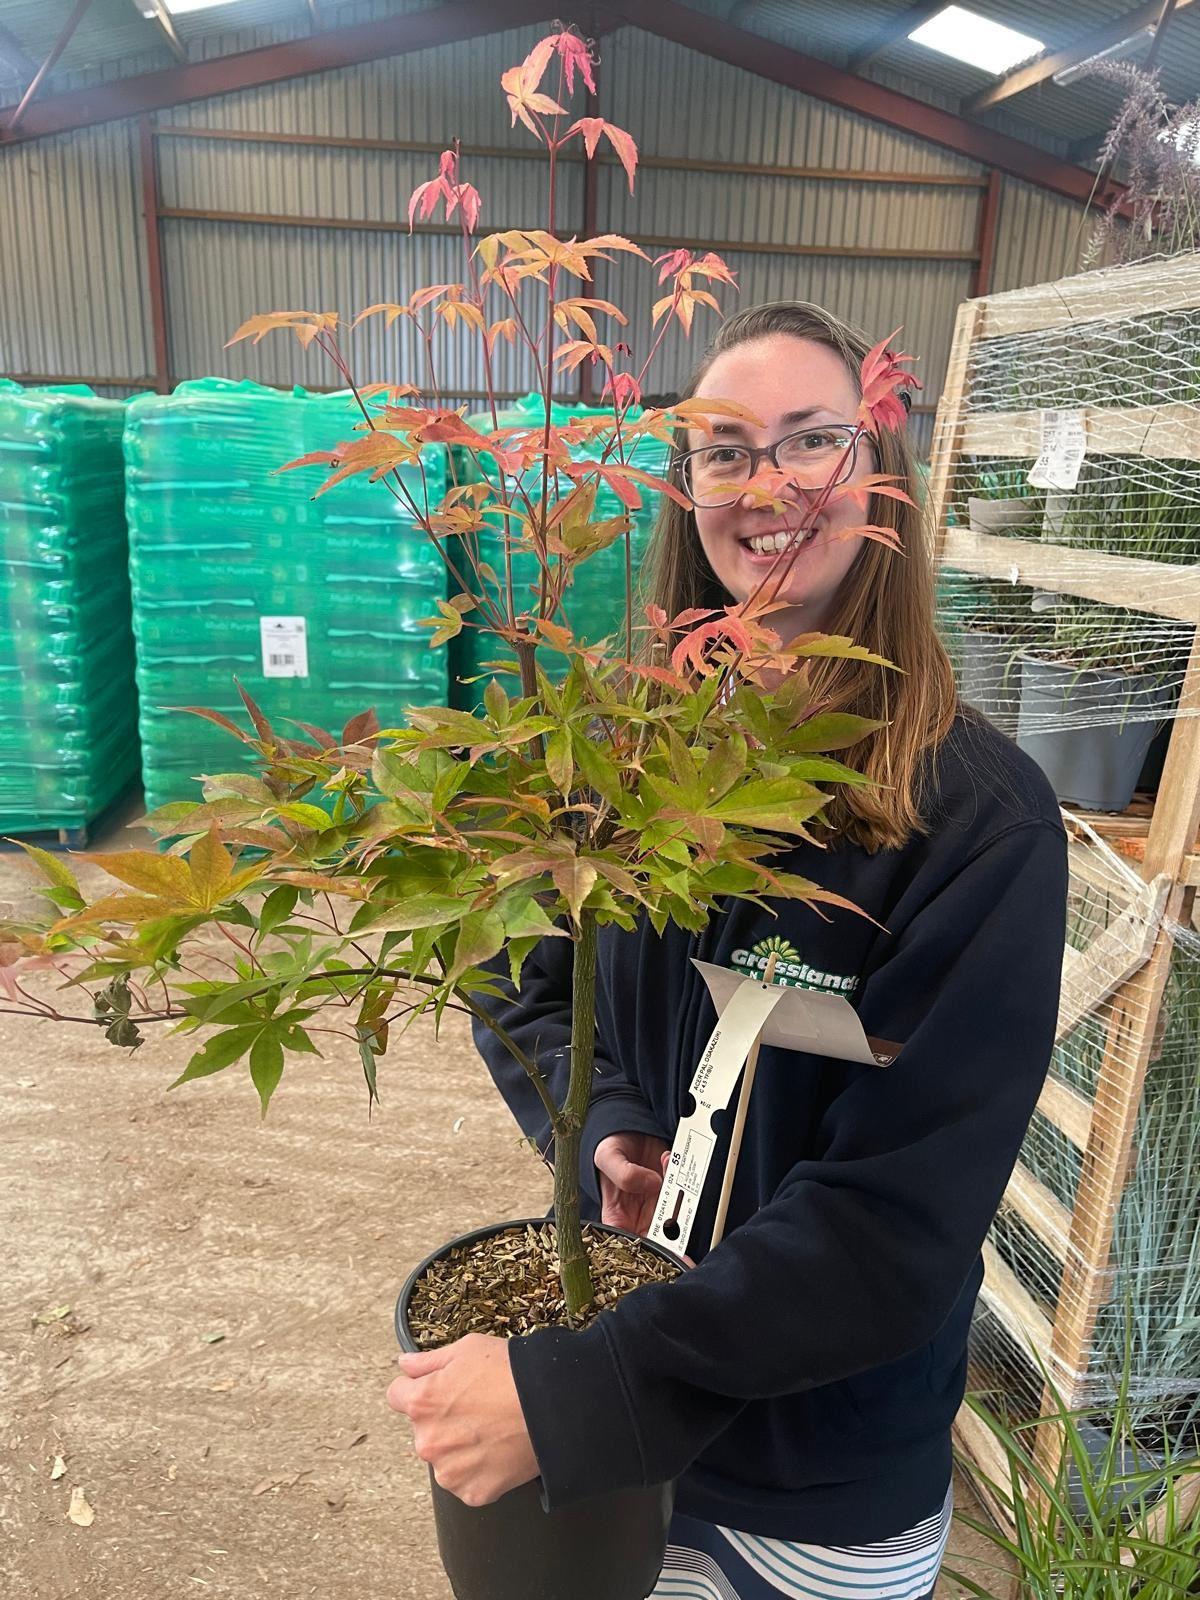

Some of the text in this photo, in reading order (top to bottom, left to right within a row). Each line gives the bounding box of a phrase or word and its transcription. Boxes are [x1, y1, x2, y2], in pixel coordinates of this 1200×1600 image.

[693, 1073, 703, 1091] ACER
[700, 1063, 708, 1075] PAL
[672, 1152, 681, 1166] 55
[652, 1225, 661, 1237] PBE
